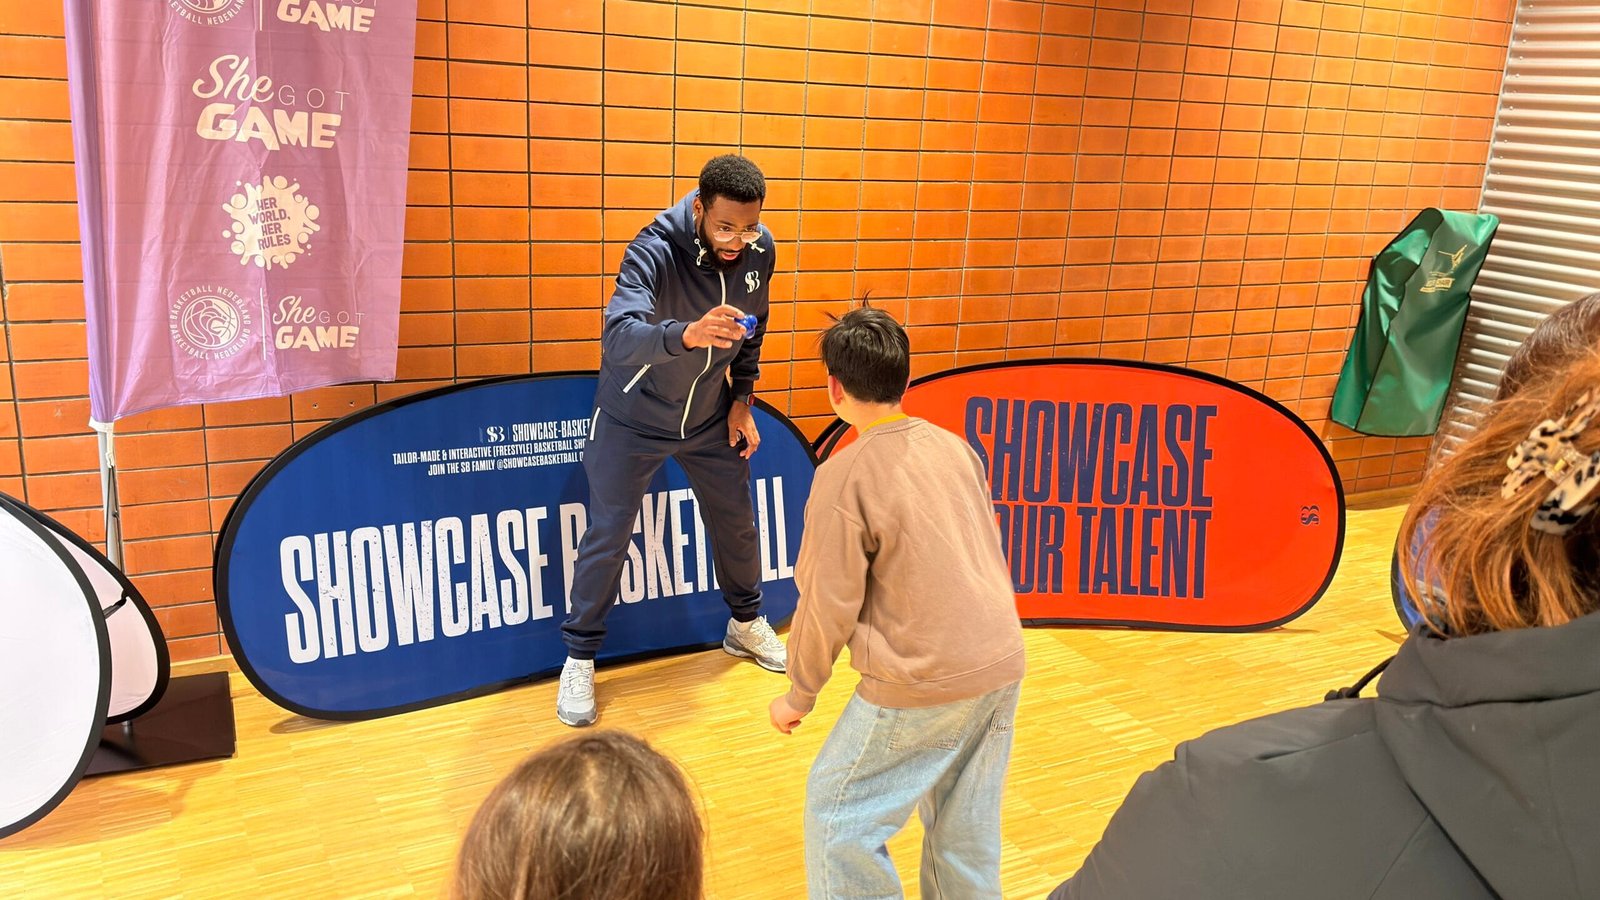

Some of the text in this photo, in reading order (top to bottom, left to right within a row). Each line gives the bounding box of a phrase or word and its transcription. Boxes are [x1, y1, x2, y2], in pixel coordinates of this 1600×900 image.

[277, 0, 375, 33] GAME
[192, 54, 350, 111] She GOT
[196, 103, 342, 150] GAME
[248, 209, 291, 225] WORLD,
[256, 197, 278, 211] HER
[258, 234, 291, 250] RULES
[261, 222, 283, 236] HER
[169, 285, 252, 325] BASKETBALL NEDERLAND
[272, 295, 365, 325] She GOT
[169, 324, 251, 360] BASKETBALL NEDERLAND
[275, 325, 360, 352] GAME
[512, 418, 591, 442] SHOWCASE-BASKET
[392, 450, 441, 465] TAILOR-MADE
[449, 446, 492, 461] INTERACTIVE
[533, 439, 573, 454] BASKETBALL
[428, 464, 446, 477] JOIN
[447, 462, 460, 475] THE
[460, 460, 471, 474] SB
[471, 458, 496, 473] FAMILY
[496, 451, 578, 471] @SHOWCASEBASKETBALL
[965, 396, 1217, 507] SHOWCASE
[993, 503, 1212, 599] OUR TALENT
[279, 476, 794, 664] SHOWCASE BSKETLL
